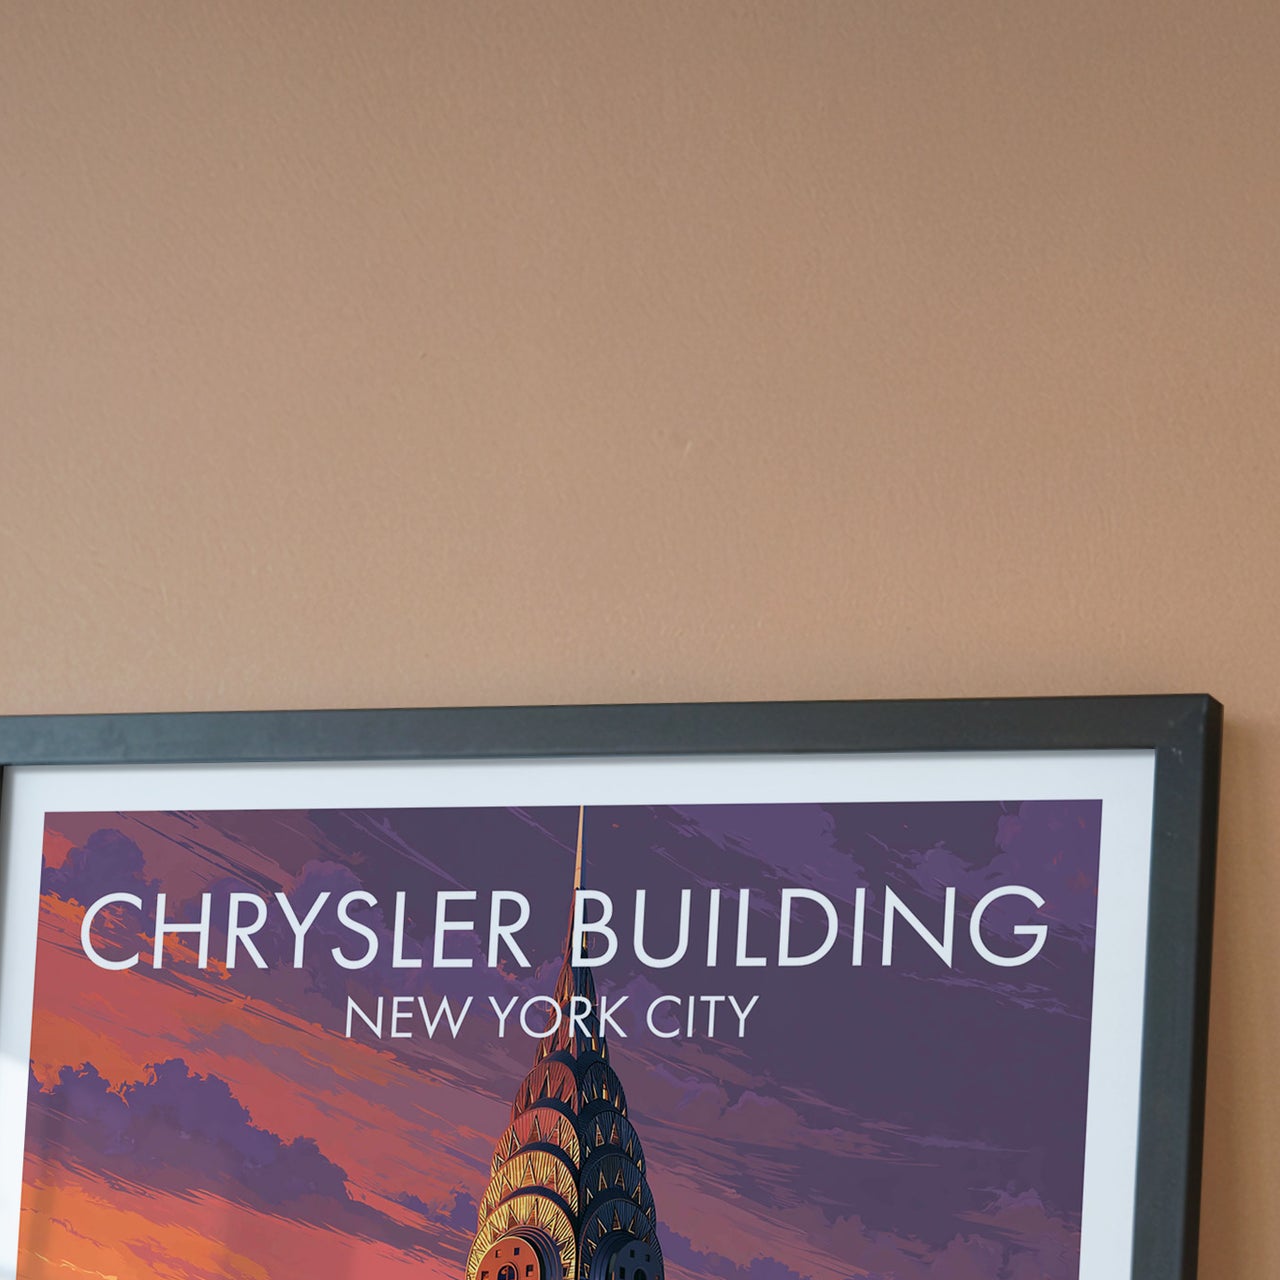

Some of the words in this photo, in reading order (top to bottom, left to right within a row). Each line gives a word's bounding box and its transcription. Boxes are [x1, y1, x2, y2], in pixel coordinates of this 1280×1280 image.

[80, 890, 532, 971] CHRYSLER
[571, 884, 1048, 969] BUILDING
[345, 995, 474, 1039] NEW
[488, 995, 629, 1039] YORK
[646, 995, 760, 1038] CITY
